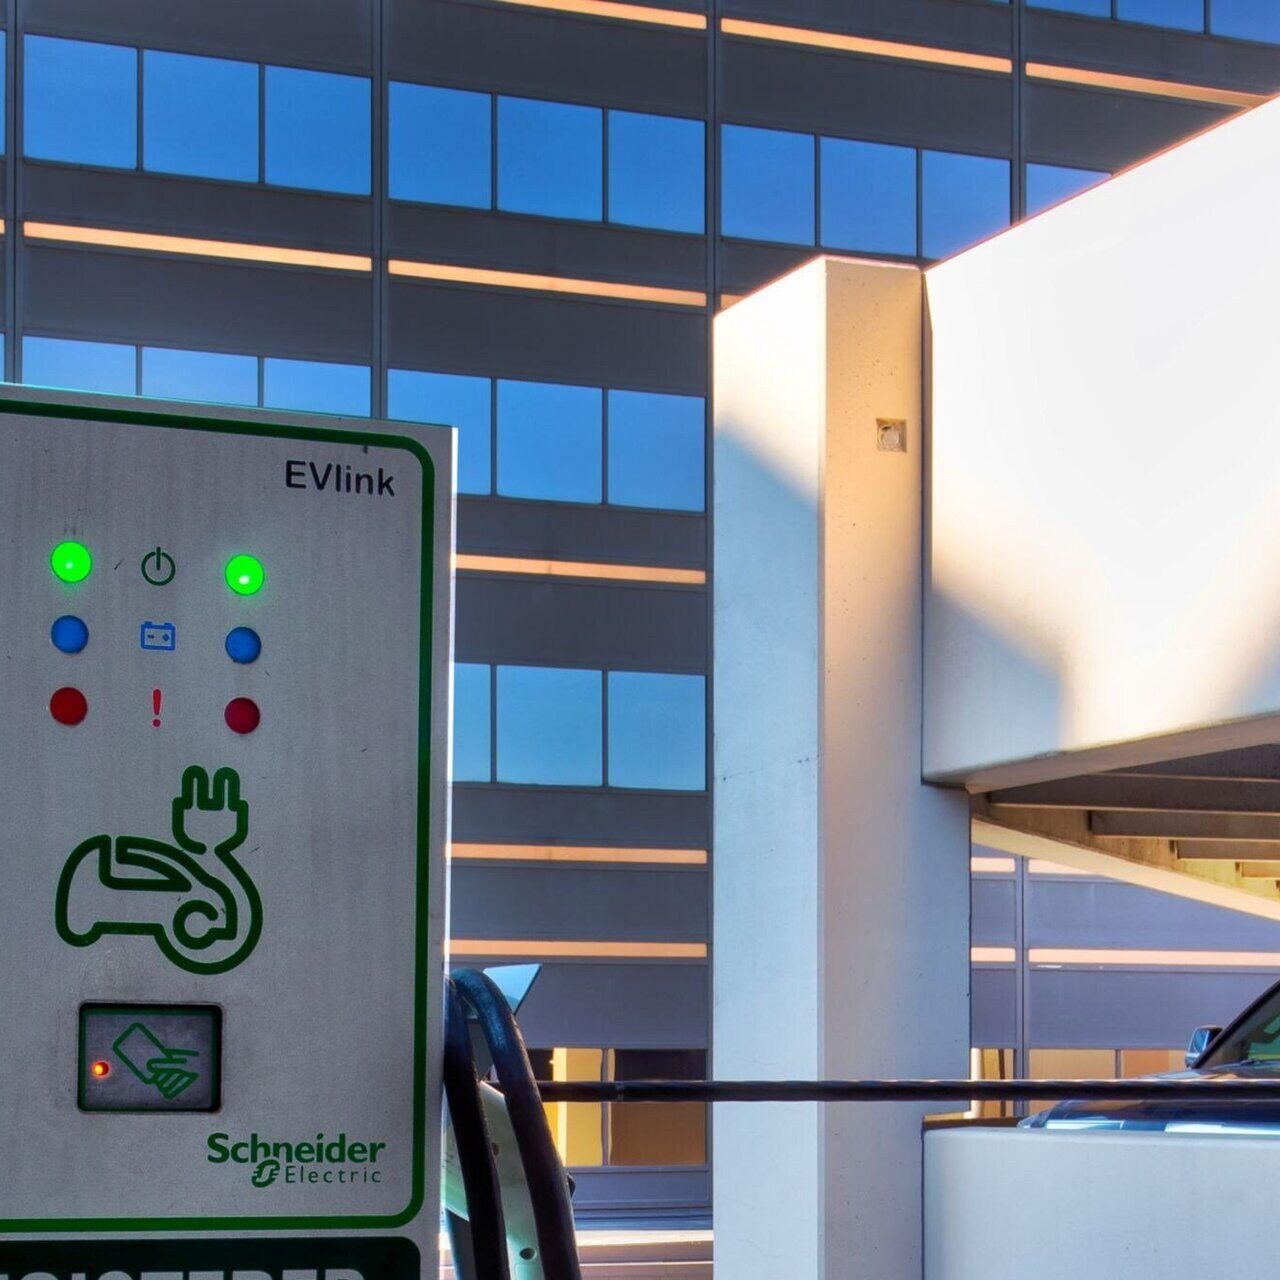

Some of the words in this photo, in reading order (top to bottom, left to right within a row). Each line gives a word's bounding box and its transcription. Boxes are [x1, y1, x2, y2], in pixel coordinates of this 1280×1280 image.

[285, 459, 395, 497] EVlink
[207, 1132, 386, 1163] Schneider
[285, 1166, 381, 1184] Electric
